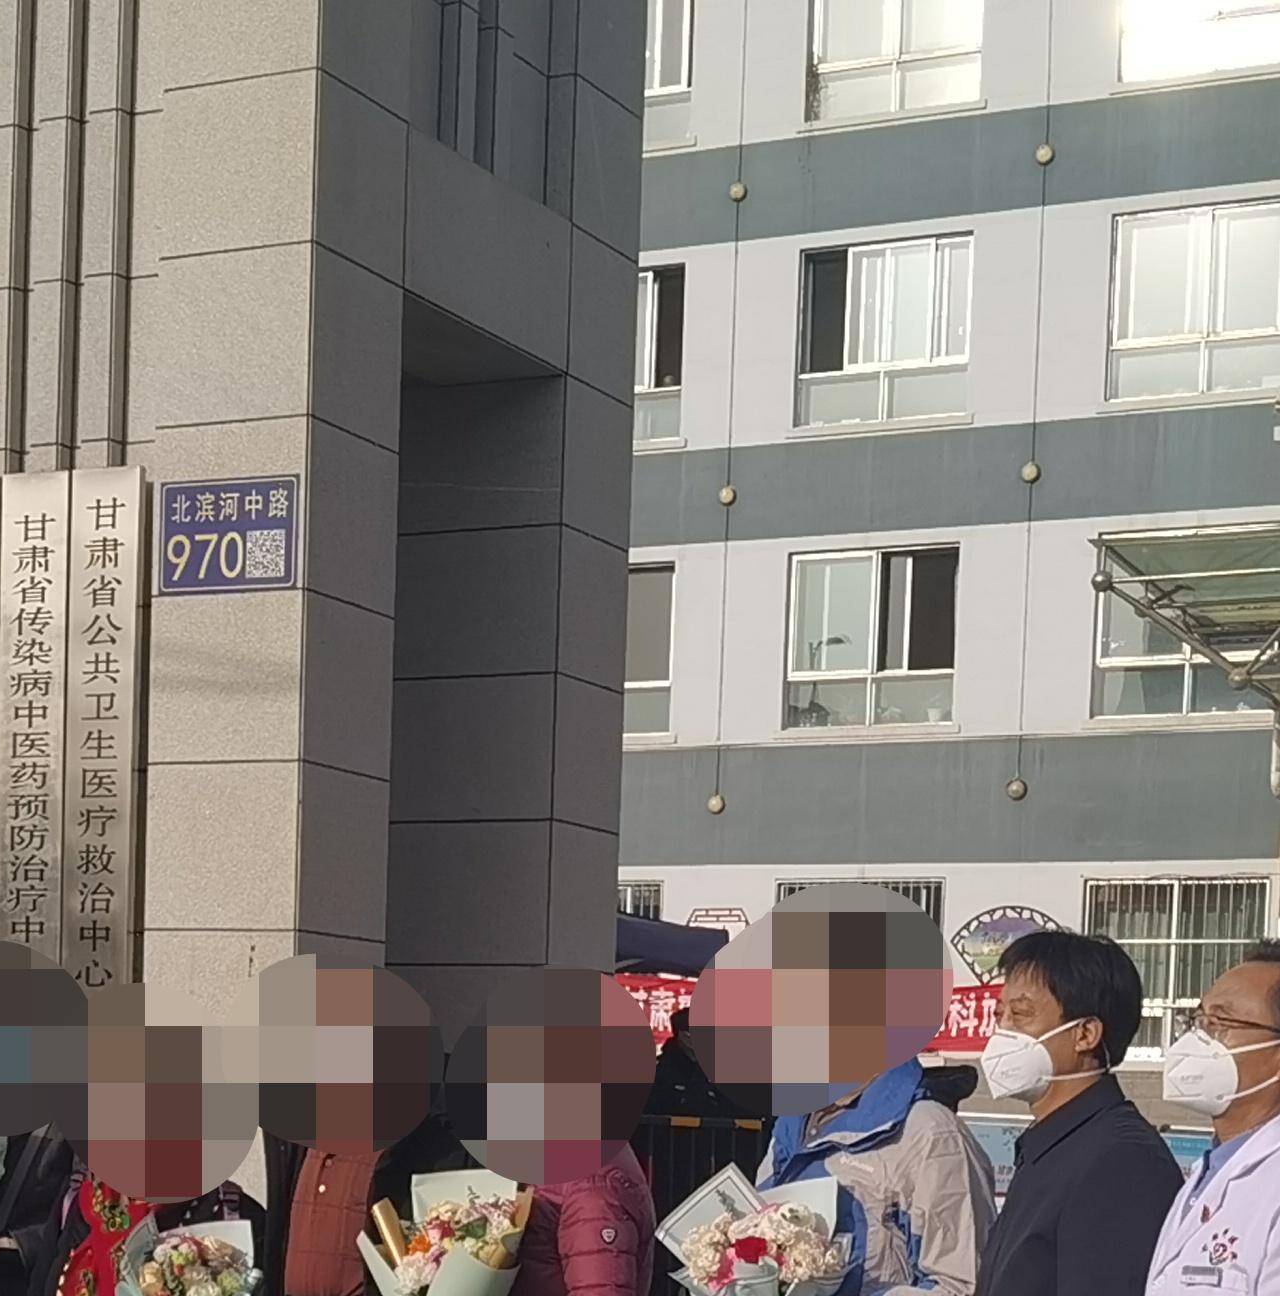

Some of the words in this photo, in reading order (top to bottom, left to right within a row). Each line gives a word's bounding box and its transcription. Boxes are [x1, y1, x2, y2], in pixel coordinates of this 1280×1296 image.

[167, 532, 245, 582] 970
[171, 489, 289, 523] 北滨河中路
[7, 513, 57, 943] 甘肃省传染病中医药预防治疗中
[75, 497, 127, 989] 甘肃省公共卫生医疗救治中心
